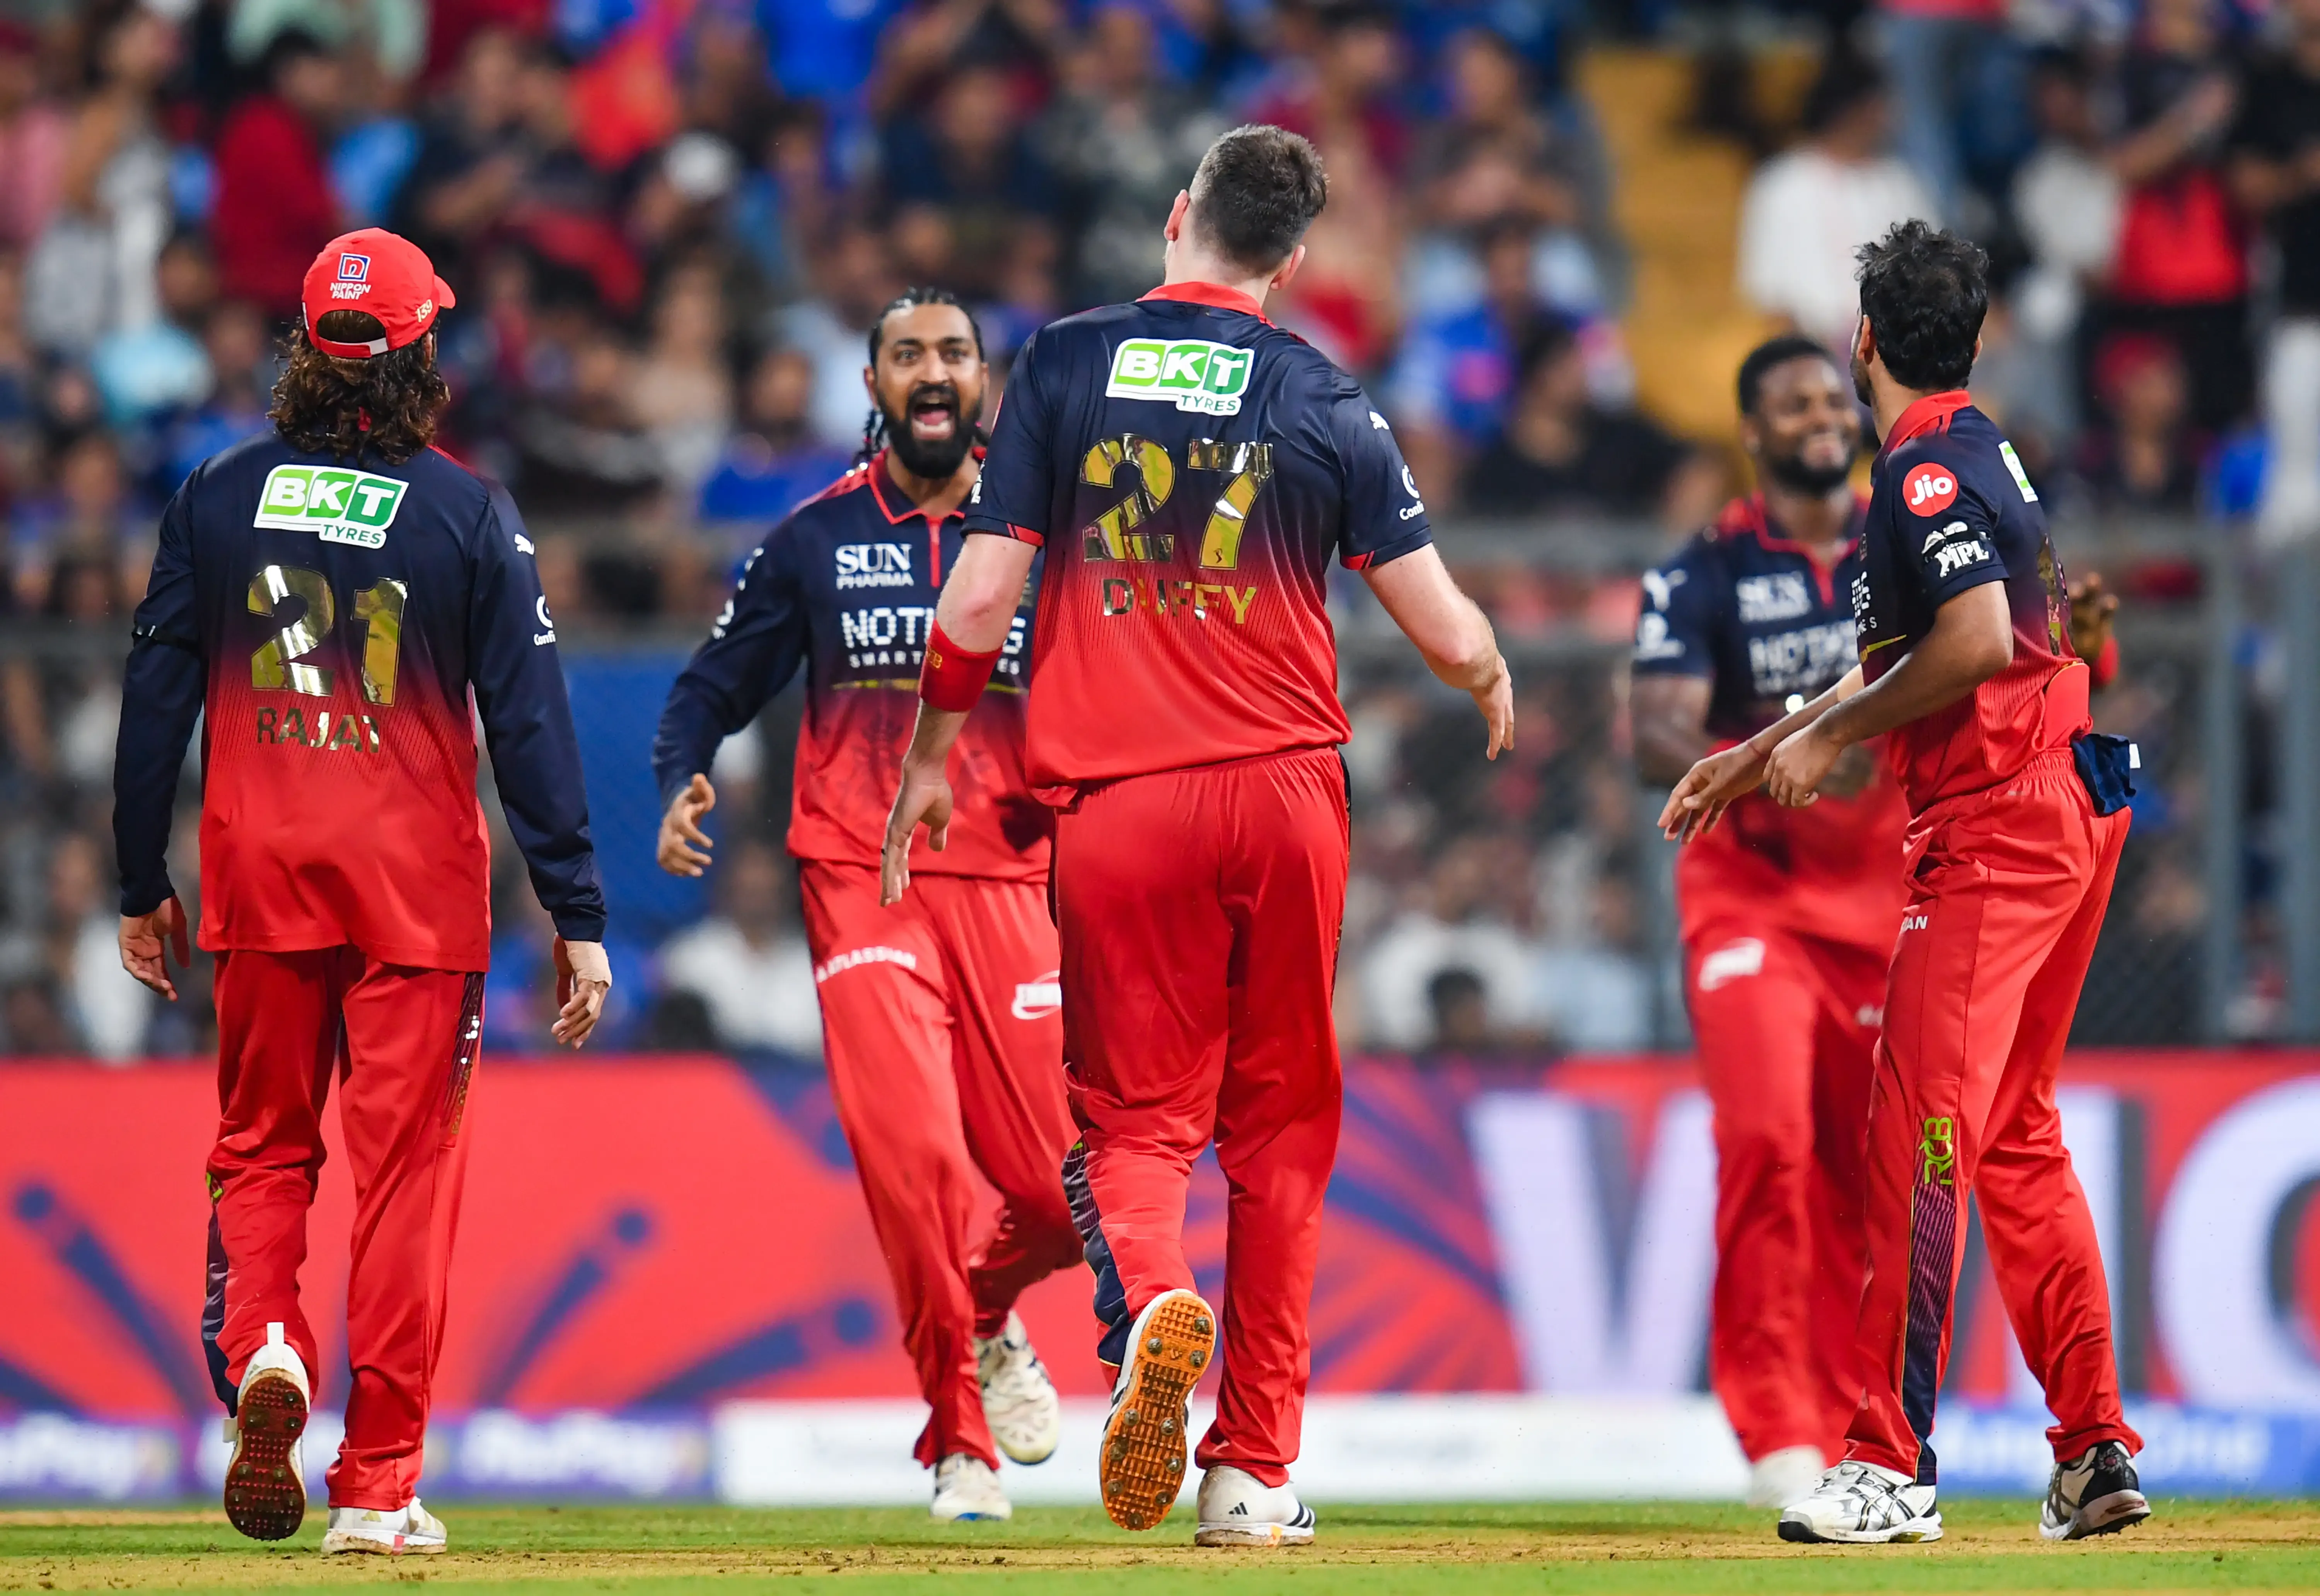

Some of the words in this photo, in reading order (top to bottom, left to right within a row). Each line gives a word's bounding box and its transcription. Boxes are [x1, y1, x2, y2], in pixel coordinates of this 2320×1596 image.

[330, 283, 371, 293] NIPPON
[332, 291, 362, 300] PAINT
[1117, 348, 1245, 388] BKT
[1181, 395, 1237, 411] TYRES
[266, 475, 395, 518] BKT
[1080, 433, 1274, 570] 27
[1911, 474, 1953, 506] Jio
[1399, 501, 1424, 520] Confi
[323, 524, 381, 545] TYRES
[835, 543, 912, 574] SUN
[836, 572, 914, 590] PHARMA
[1103, 579, 1257, 624] DUFFY
[247, 565, 408, 707] 21
[534, 630, 556, 646] Confi
